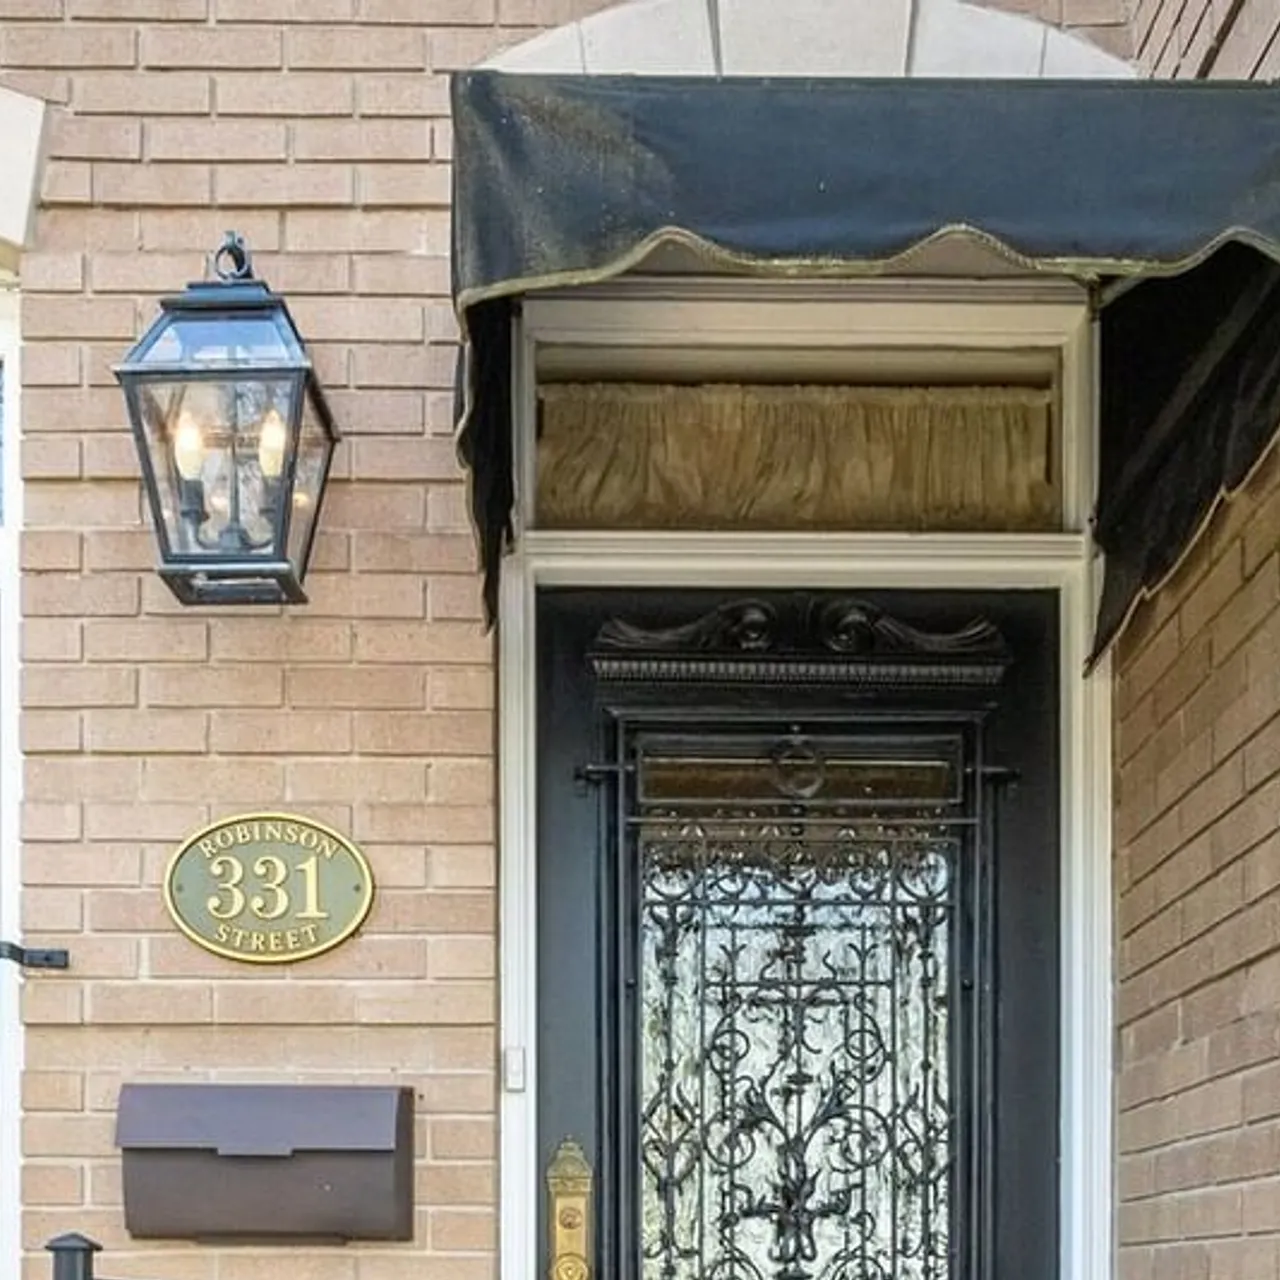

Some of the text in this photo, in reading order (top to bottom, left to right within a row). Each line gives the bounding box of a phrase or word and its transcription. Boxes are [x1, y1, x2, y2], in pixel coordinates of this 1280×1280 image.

[197, 822, 341, 859] ROBINSON
[207, 855, 329, 920] 331
[215, 923, 319, 951] STREET
